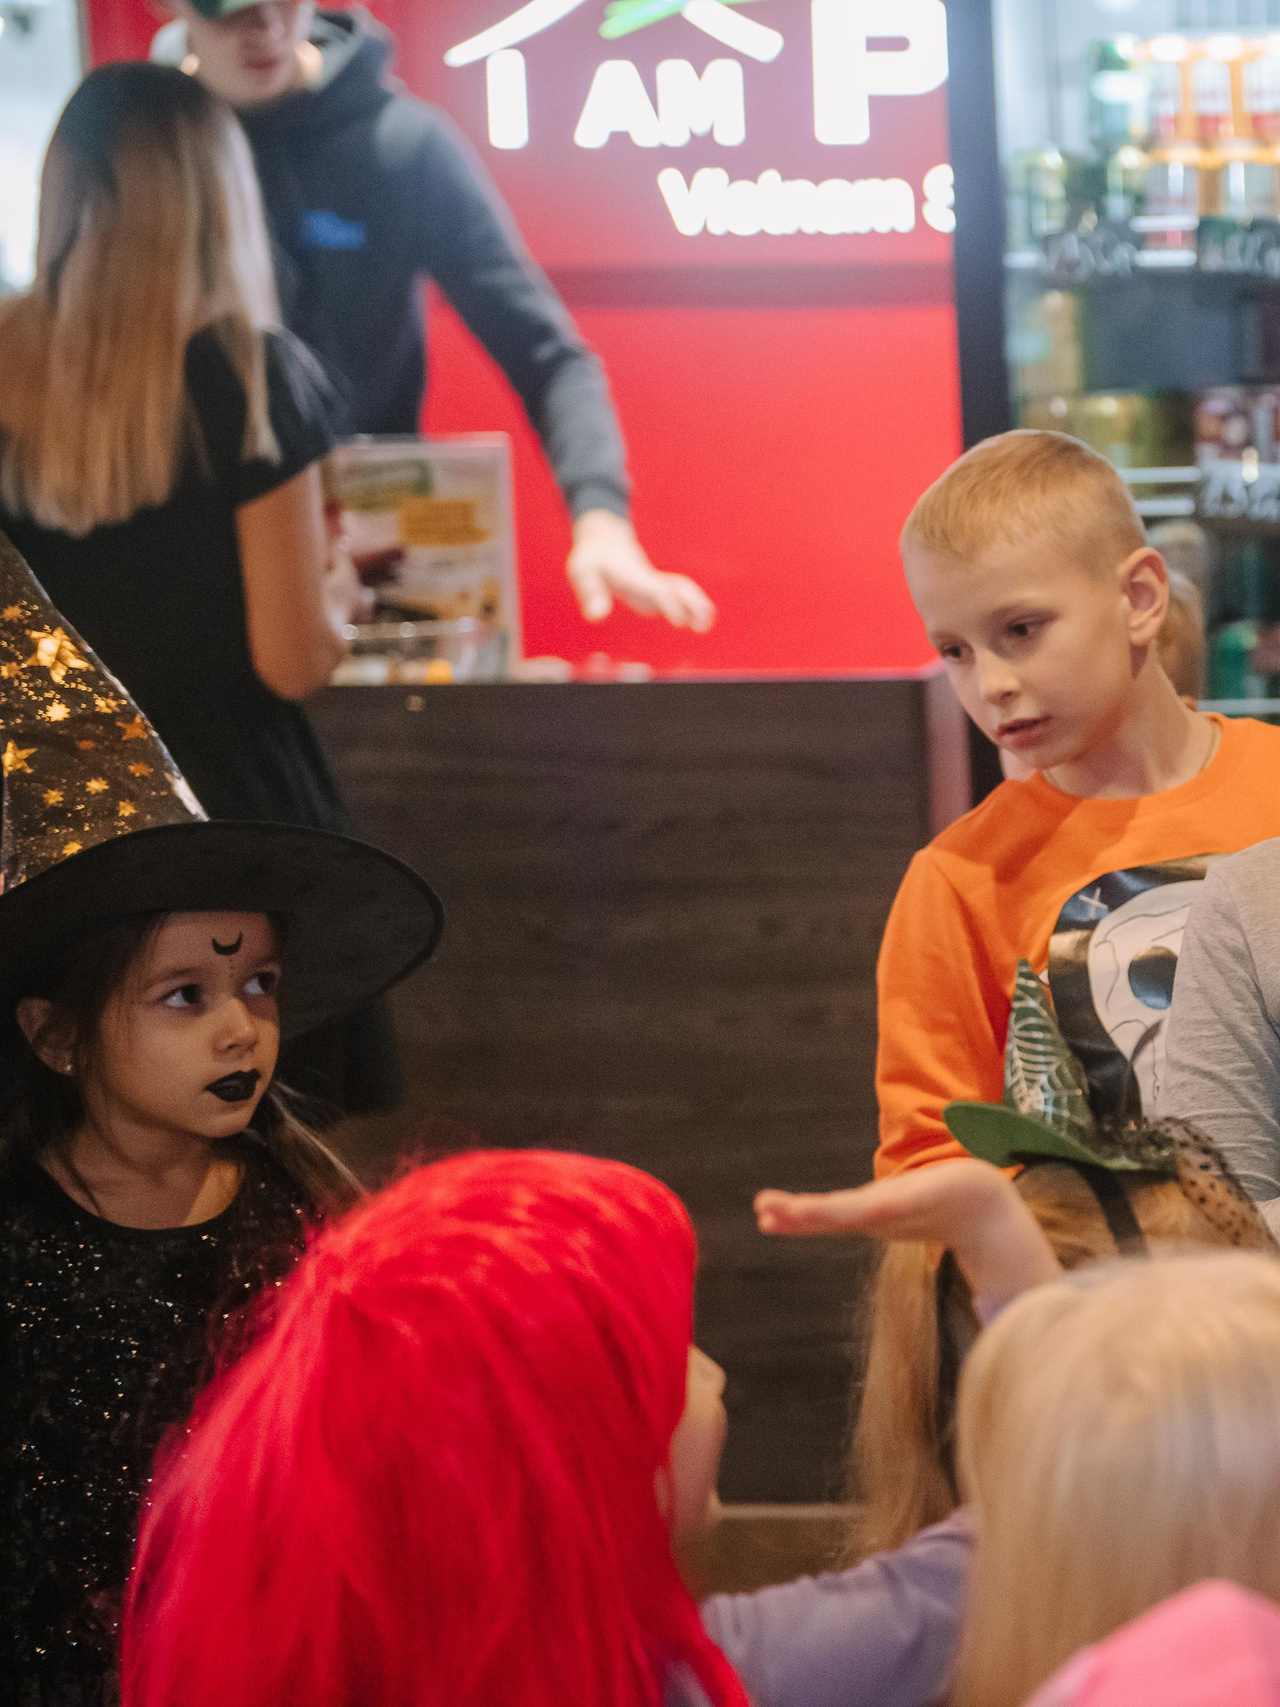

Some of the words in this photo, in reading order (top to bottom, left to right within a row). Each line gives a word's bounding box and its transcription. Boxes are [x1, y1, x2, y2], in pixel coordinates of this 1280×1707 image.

[486, 49, 529, 149] I
[573, 58, 746, 148] AM
[657, 166, 916, 236] Vietnam
